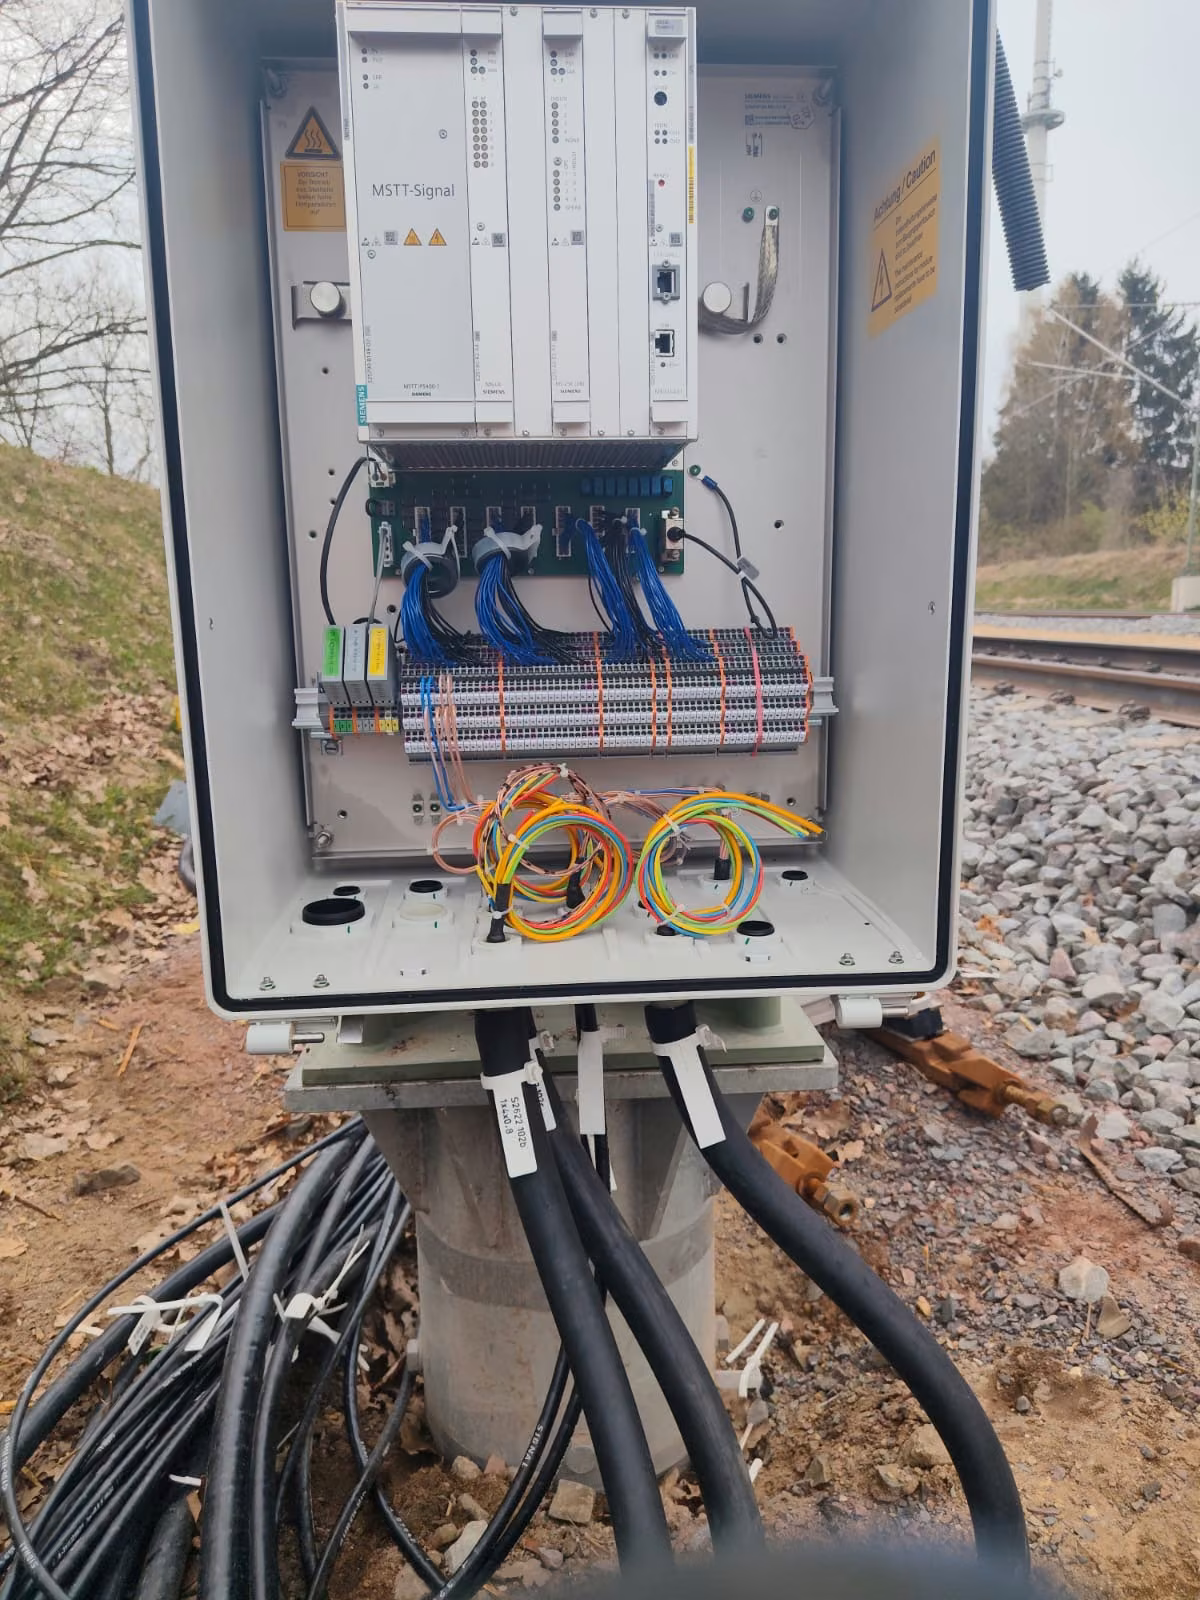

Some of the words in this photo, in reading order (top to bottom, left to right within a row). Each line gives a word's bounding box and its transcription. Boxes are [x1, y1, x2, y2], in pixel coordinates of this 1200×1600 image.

[372, 183, 455, 200] MSTT-Signal
[874, 185, 900, 224] Achtung
[906, 150, 935, 188] Caution
[358, 386, 366, 424] SIEMENS
[510, 1096, 523, 1125] S2622
[517, 1127, 528, 1148] 102b
[523, 1423, 543, 1467] SIGNAL
